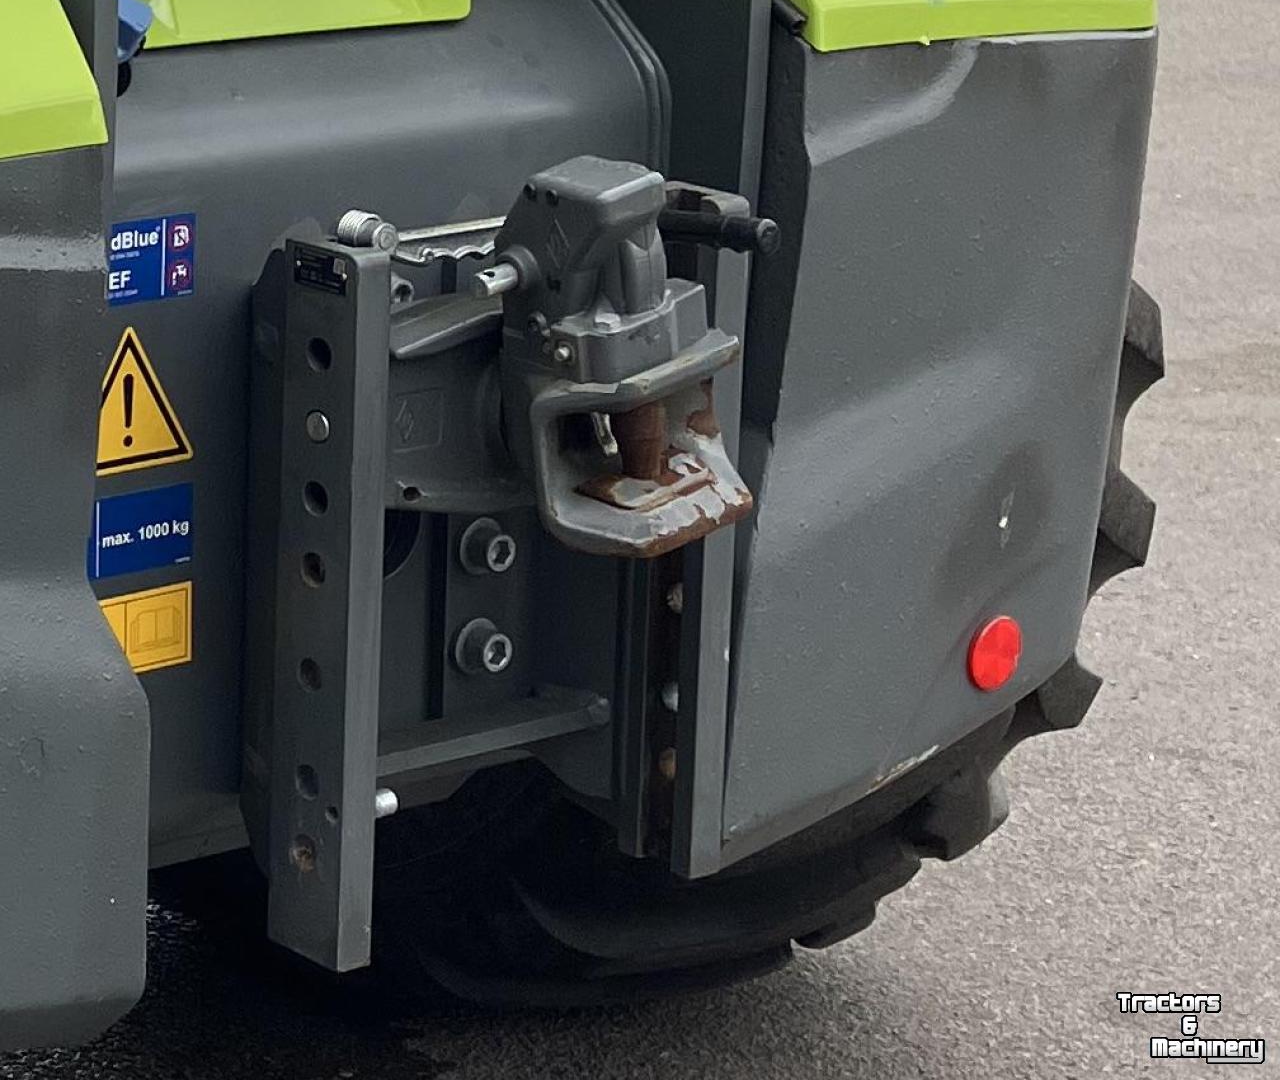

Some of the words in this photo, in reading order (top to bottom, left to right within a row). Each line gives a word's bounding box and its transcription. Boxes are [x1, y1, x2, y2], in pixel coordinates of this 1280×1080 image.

[110, 230, 159, 251] dBlue
[108, 270, 132, 290] EF
[102, 532, 135, 548] max.
[138, 522, 170, 540] 1000
[172, 519, 189, 536] kg
